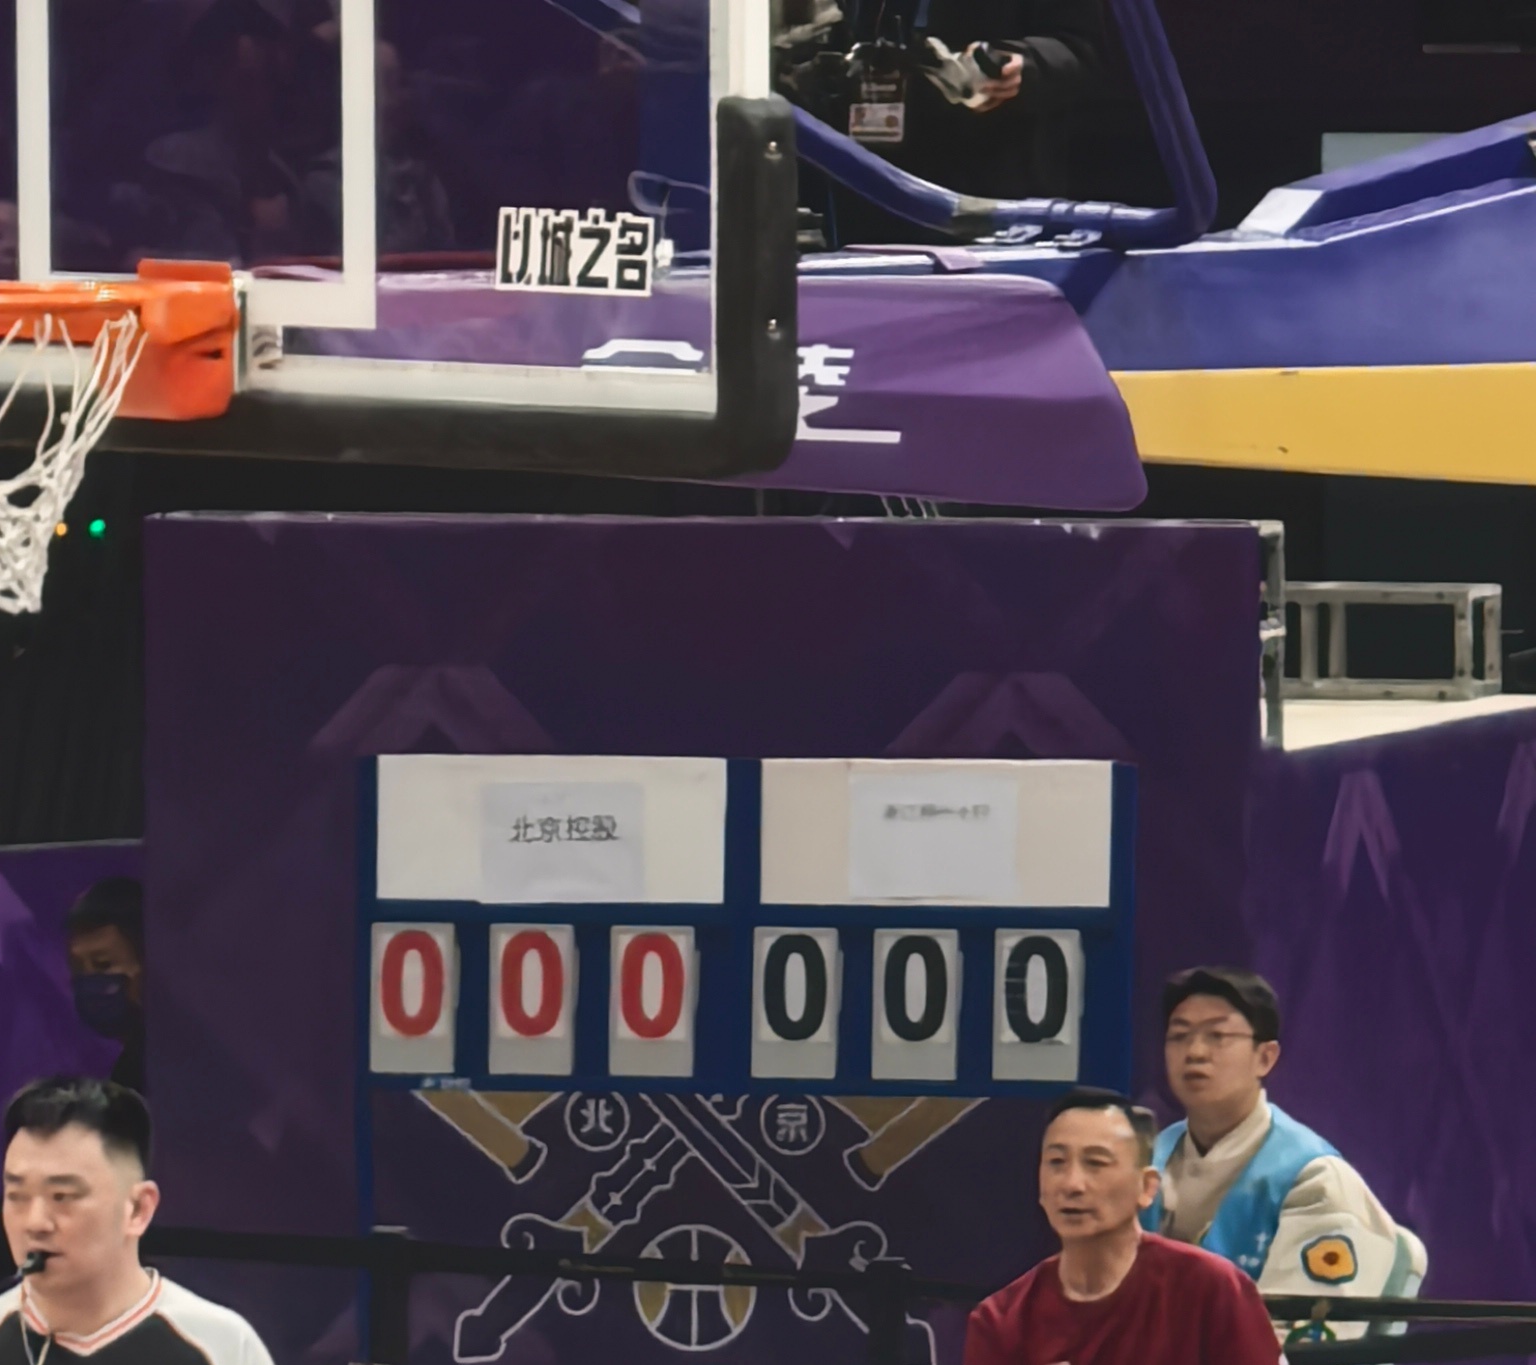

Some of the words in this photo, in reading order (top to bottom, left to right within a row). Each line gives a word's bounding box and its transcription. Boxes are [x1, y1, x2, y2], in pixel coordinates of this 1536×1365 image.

[500, 212, 650, 291] 以城之名
[579, 1098, 613, 1134] 北
[776, 1103, 809, 1143] 京
